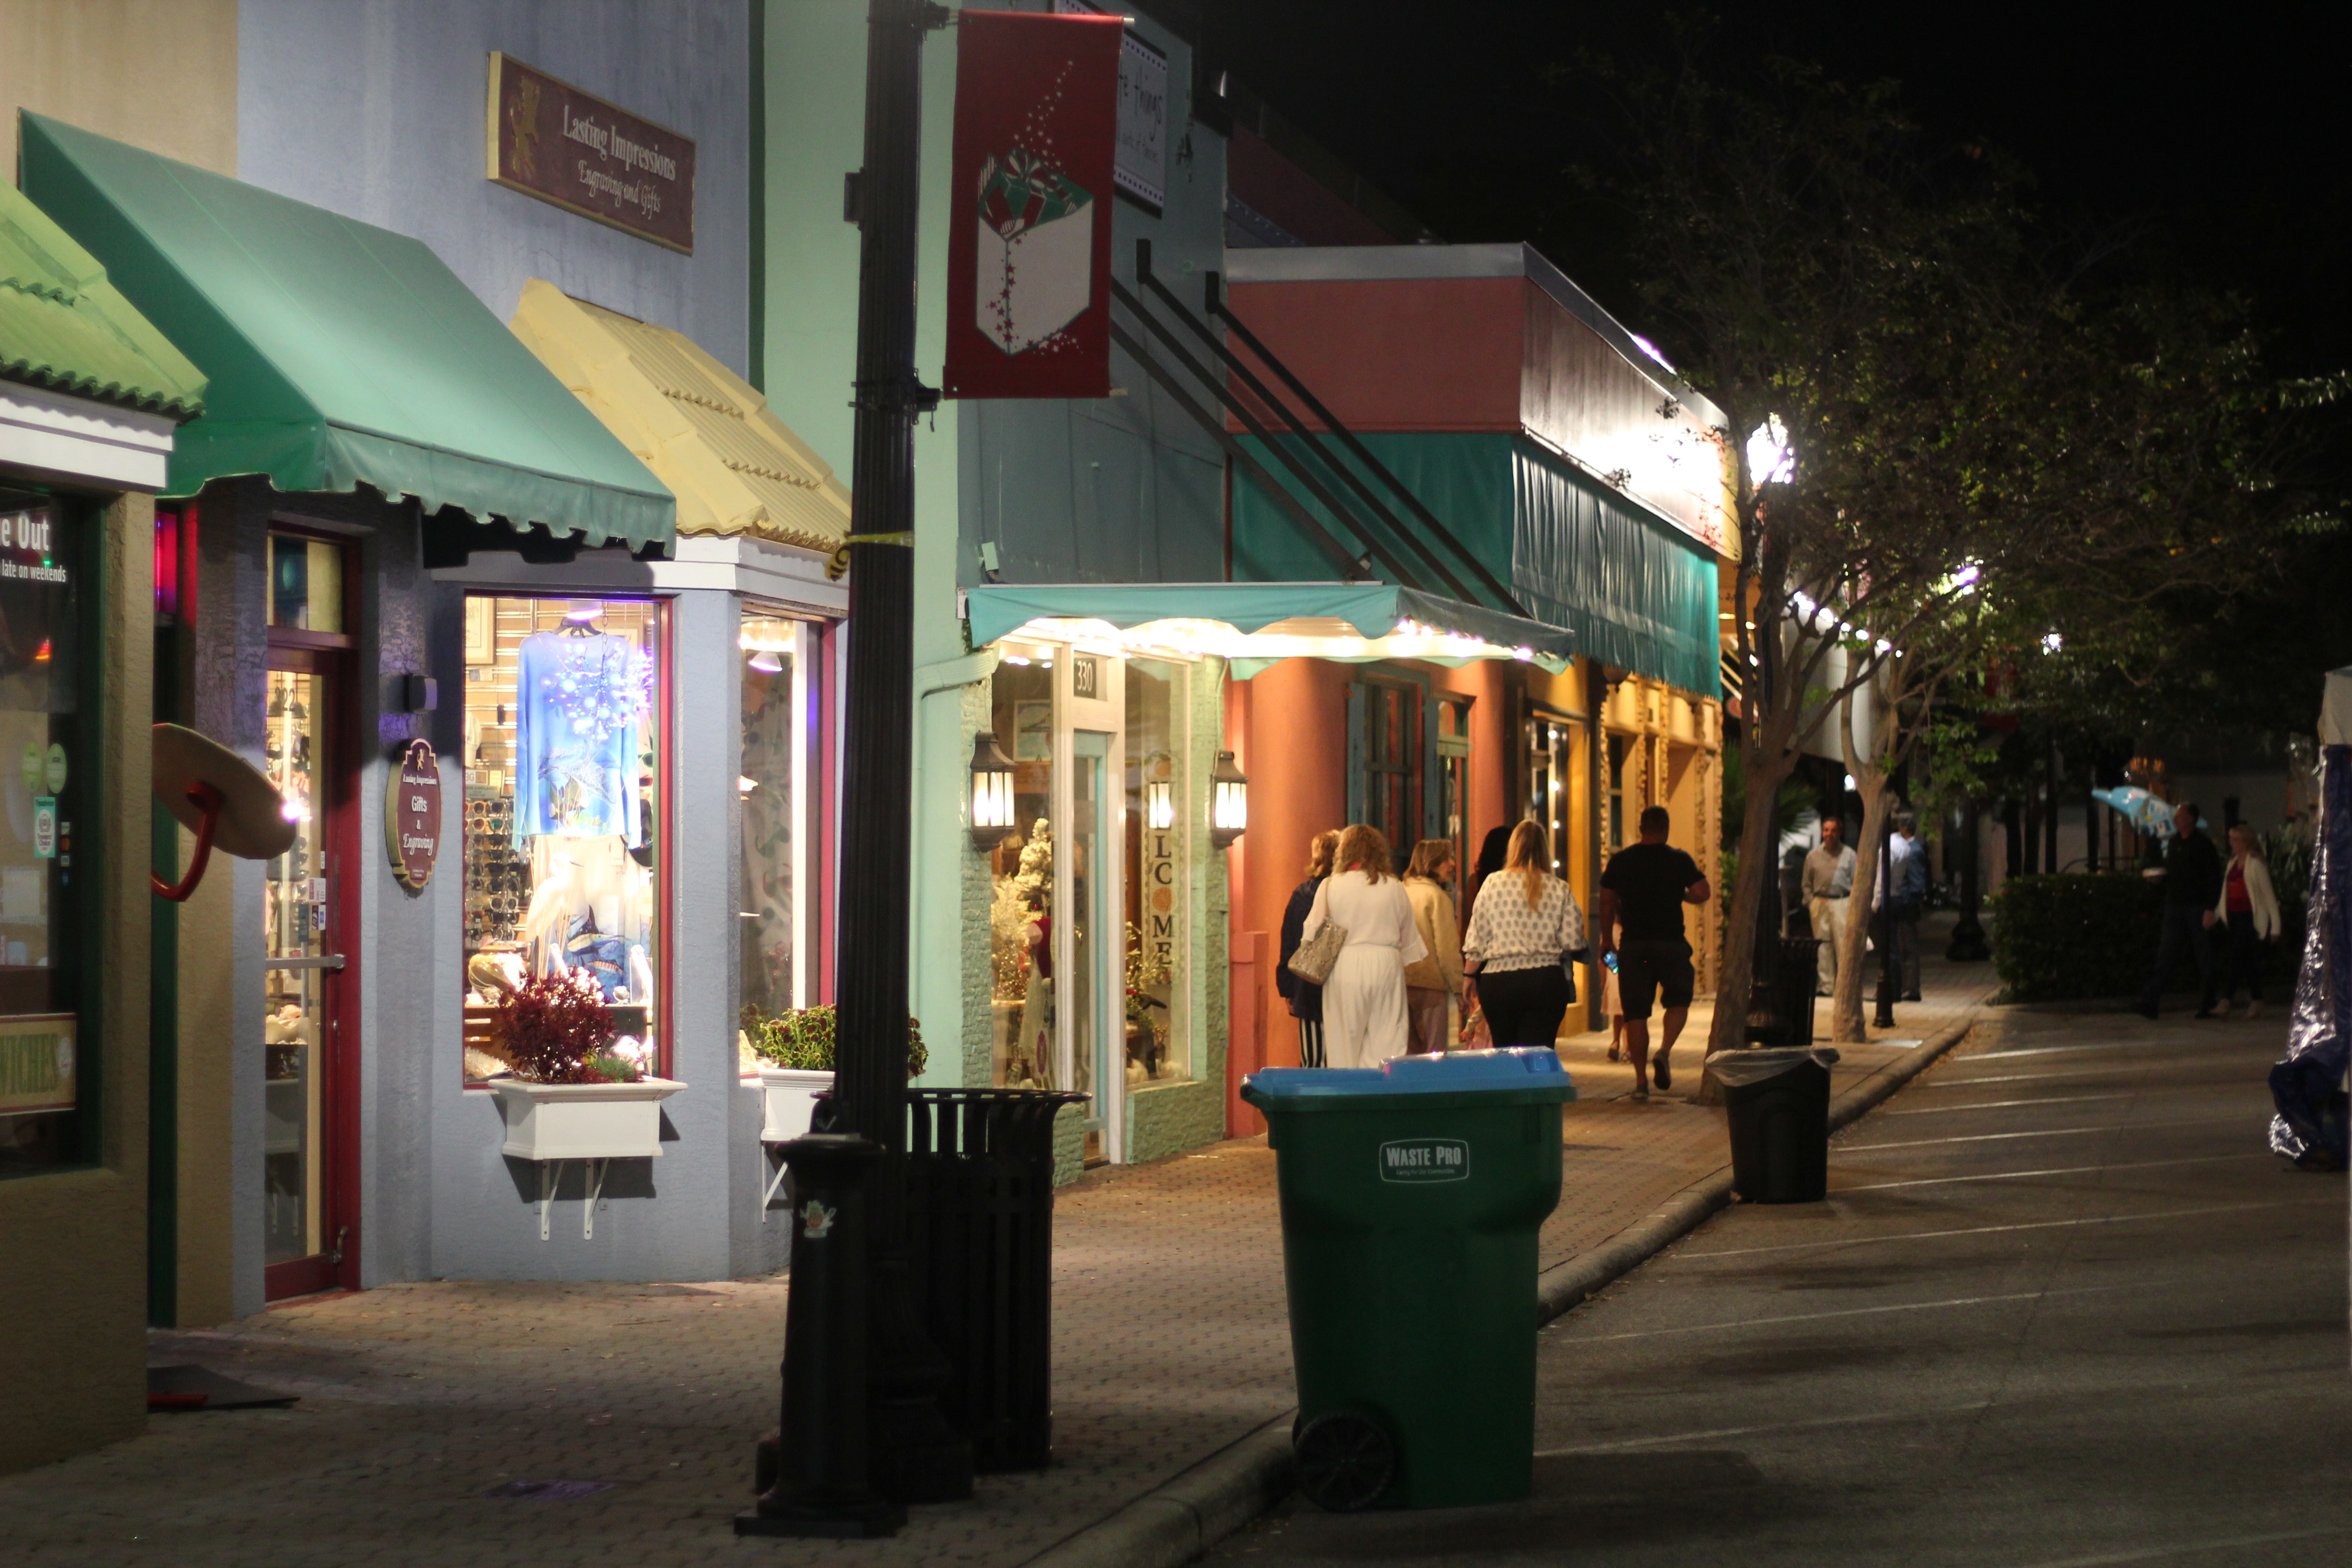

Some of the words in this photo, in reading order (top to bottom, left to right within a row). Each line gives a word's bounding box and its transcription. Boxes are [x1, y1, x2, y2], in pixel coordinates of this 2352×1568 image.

[562, 104, 608, 161] Lasting
[610, 125, 676, 181] Impressions
[578, 159, 623, 208] Engraving
[624, 180, 639, 204] and
[641, 185, 661, 220] Gifts
[18, 511, 49, 551] Out
[2, 559, 17, 578] late
[19, 564, 28, 579] on
[30, 564, 67, 583] weekends
[1077, 660, 1093, 692] 330
[403, 774, 416, 785] Lasting
[412, 795, 427, 813] Gifts
[416, 819, 421, 830] &
[403, 833, 434, 856] Engraving
[1386, 1147, 1431, 1167] WASTE
[1436, 1146, 1462, 1165] PRO
